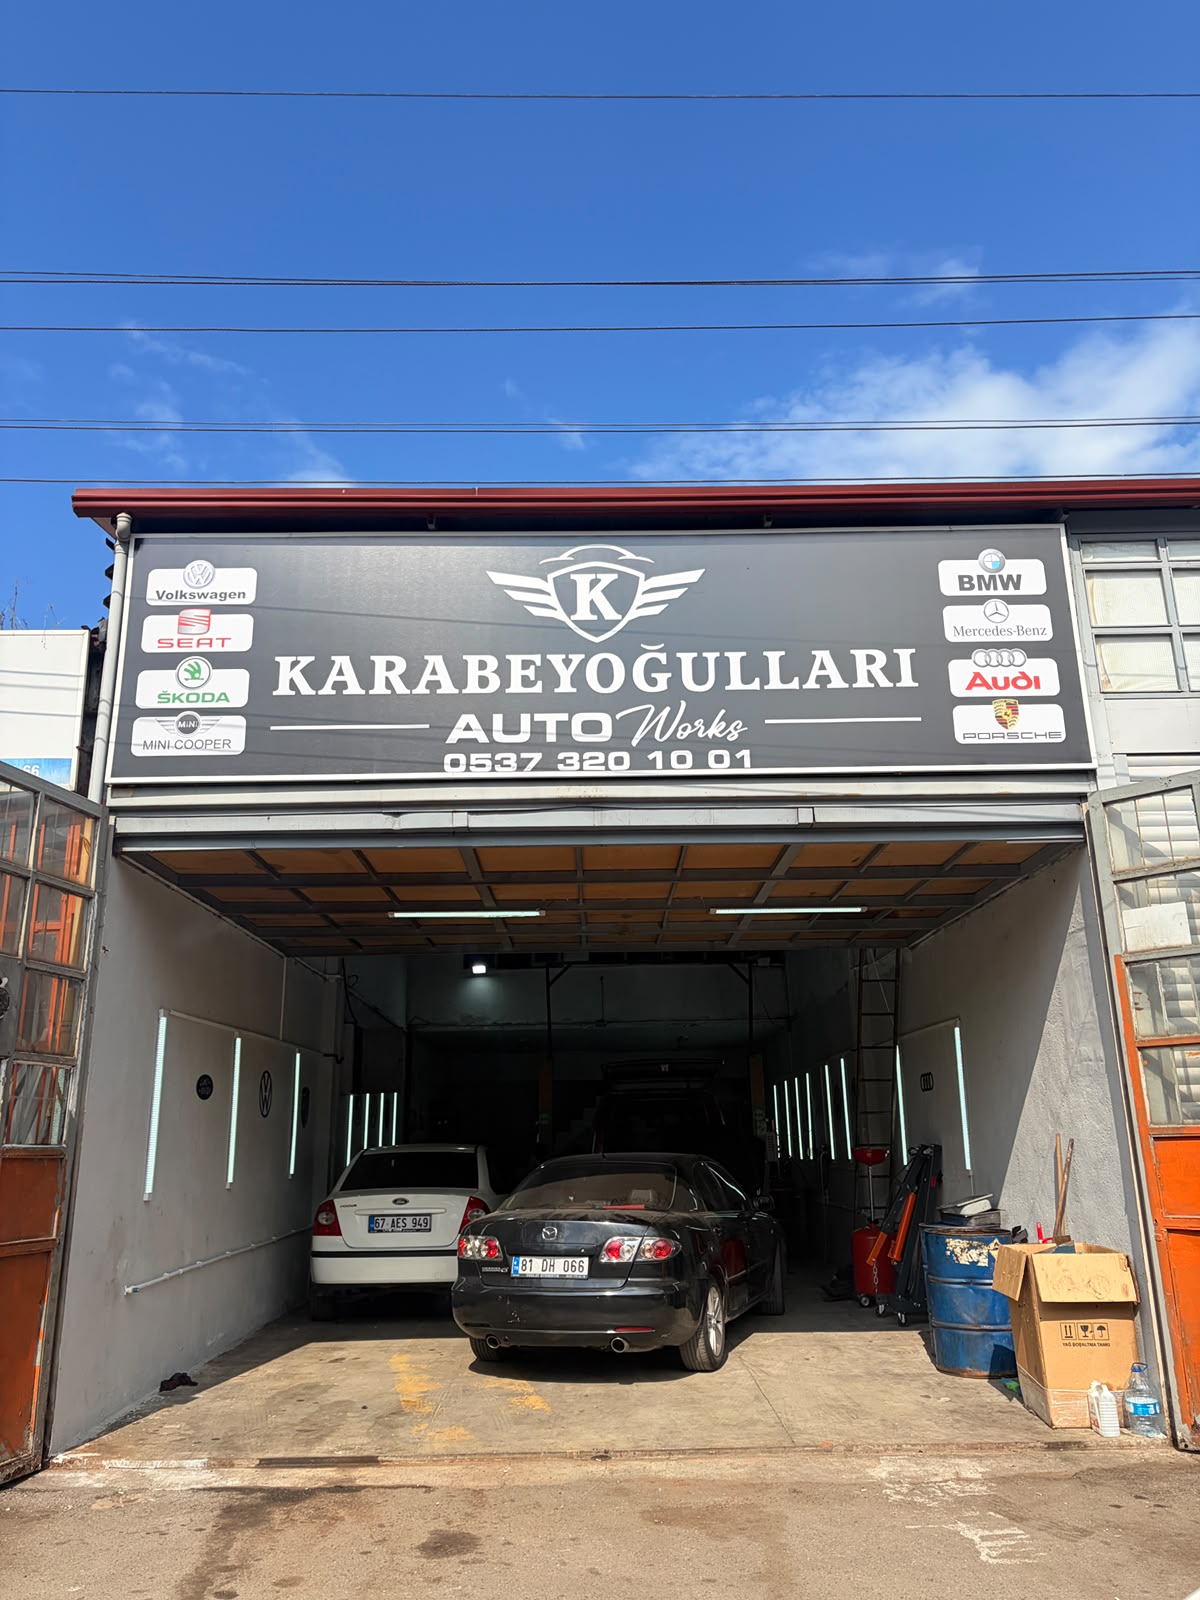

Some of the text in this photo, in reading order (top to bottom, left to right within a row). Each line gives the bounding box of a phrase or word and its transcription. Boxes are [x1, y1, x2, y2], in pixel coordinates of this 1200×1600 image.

[957, 574, 1022, 591] BMW
[155, 590, 246, 601] Volkswagen
[570, 573, 622, 621] K
[953, 625, 1048, 637] Mercedes-Benz
[157, 638, 232, 648] SEAT
[272, 643, 919, 696] KARABEYOĞULLARI
[965, 671, 1041, 690] Audi
[157, 690, 230, 704] ŠKODA
[445, 700, 748, 747] AUTO Works
[962, 731, 1062, 740] PORSCHE
[142, 739, 231, 750] MINI COOPER
[443, 749, 751, 772] 0537 320 10 01
[374, 1217, 429, 1229] 67 AES 949
[520, 1258, 533, 1272] 81
[541, 1259, 555, 1272] DH
[562, 1259, 585, 1273] 066
